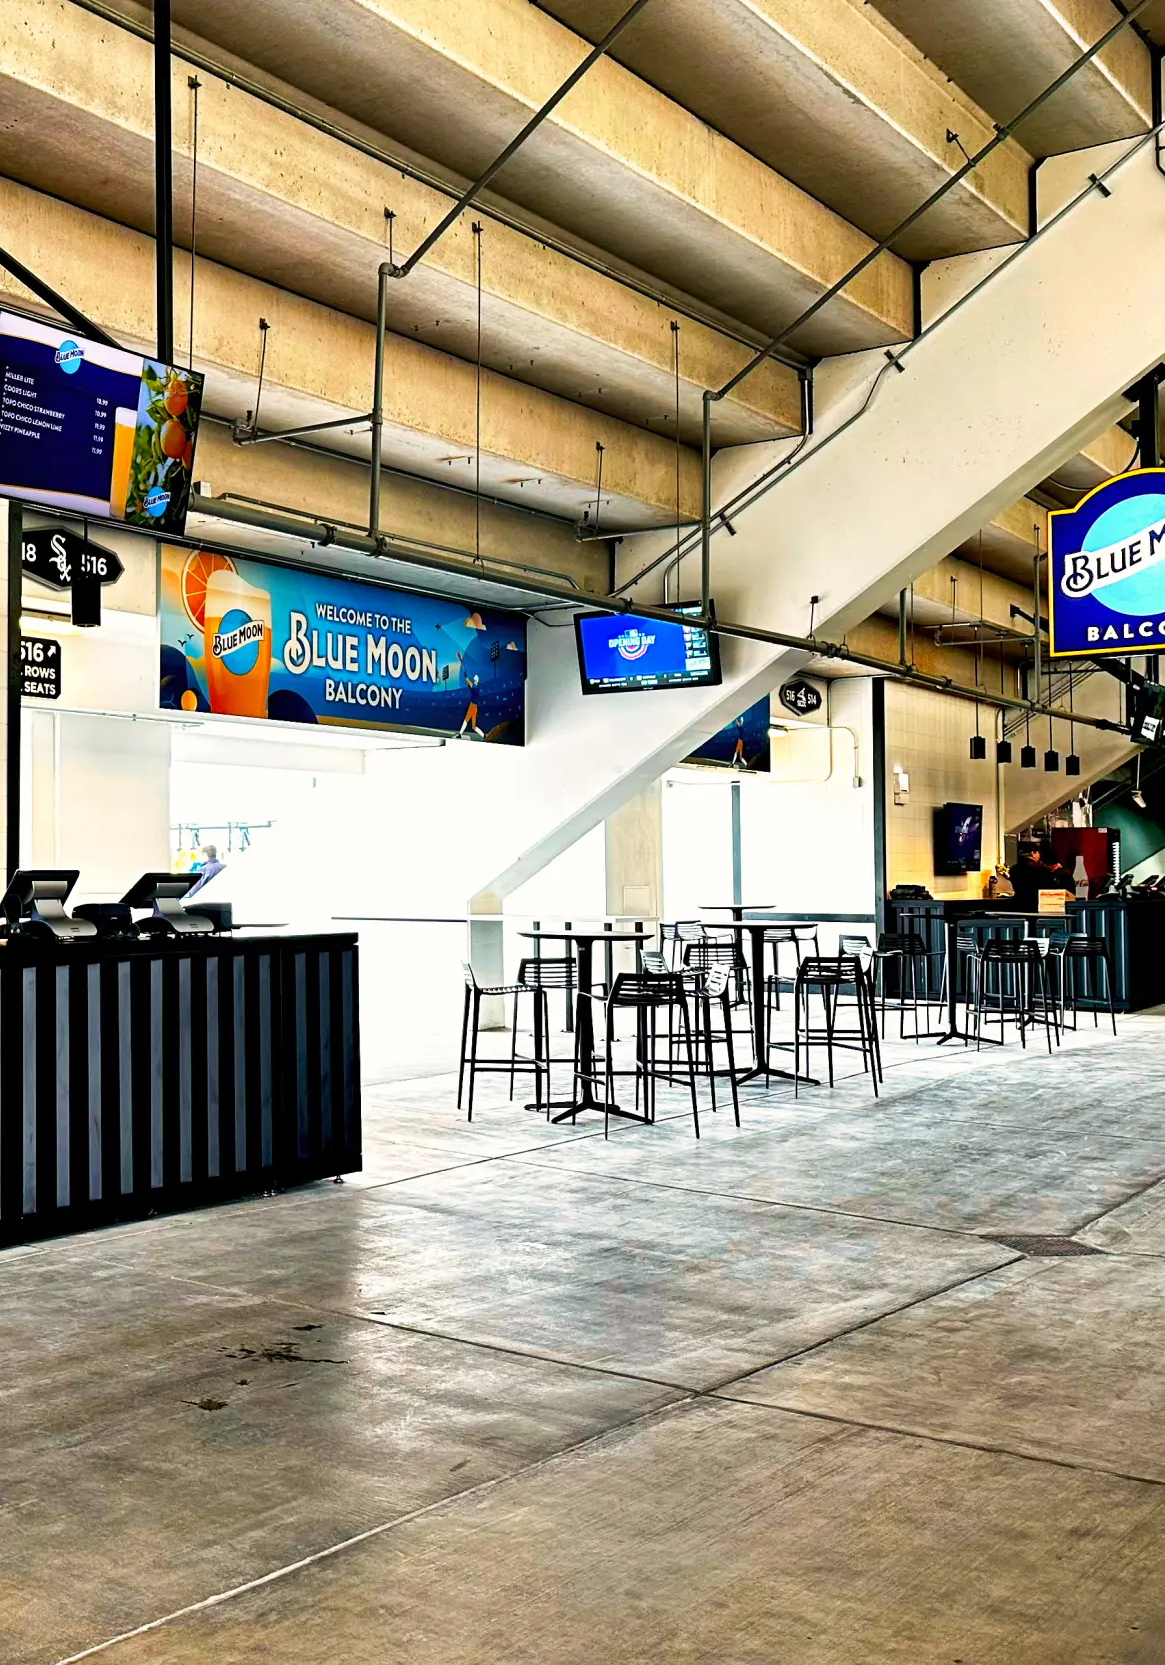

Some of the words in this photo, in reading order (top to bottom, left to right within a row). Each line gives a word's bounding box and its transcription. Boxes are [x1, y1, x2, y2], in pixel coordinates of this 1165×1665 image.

[5, 372, 23, 382] MILLER
[23, 376, 35, 385] LITE
[3, 384, 23, 395] COORS
[23, 390, 37, 398] LIGHT
[3, 396, 17, 406] TOPO
[17, 401, 33, 411] CHICO
[33, 405, 65, 420] STRAWBERRY
[0, 423, 14, 432] VIZZY
[13, 426, 41, 440] PINEAPPLE
[1, 410, 15, 420] TOPO
[15, 414, 33, 424] CHICO
[32, 418, 51, 429] LEMON
[51, 423, 63, 432] LIME
[1065, 540, 1143, 592] BLUE
[315, 602, 373, 628] WELCOME
[375, 614, 389, 630] TO
[391, 617, 412, 635] THE
[213, 633, 237, 656] BLUE
[239, 624, 263, 644] MOON
[283, 612, 361, 675] BLUE
[367, 634, 437, 684] MOON
[608, 637, 641, 648] OPENING
[641, 634, 655, 646] DAY
[24, 665, 56, 680] ROWS
[24, 681, 56, 695] SEATS
[325, 678, 403, 710] BALCONY
